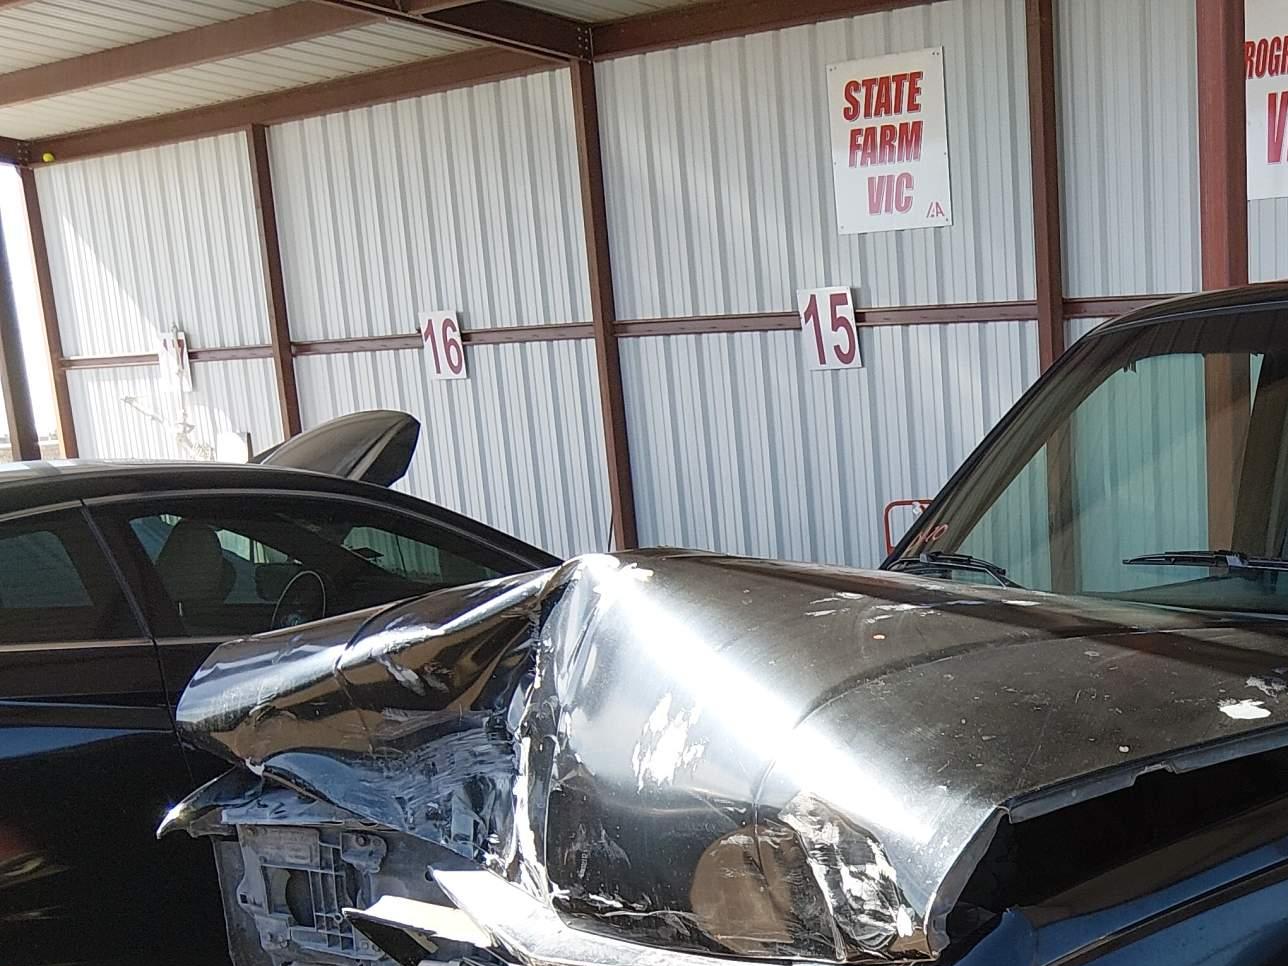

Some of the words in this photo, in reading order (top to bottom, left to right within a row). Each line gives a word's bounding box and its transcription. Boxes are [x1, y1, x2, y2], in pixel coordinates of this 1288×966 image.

[843, 71, 924, 122] STATE
[848, 120, 924, 169] FARM
[867, 172, 915, 216] VIC
[424, 318, 463, 375] 16
[804, 293, 856, 365] 15
